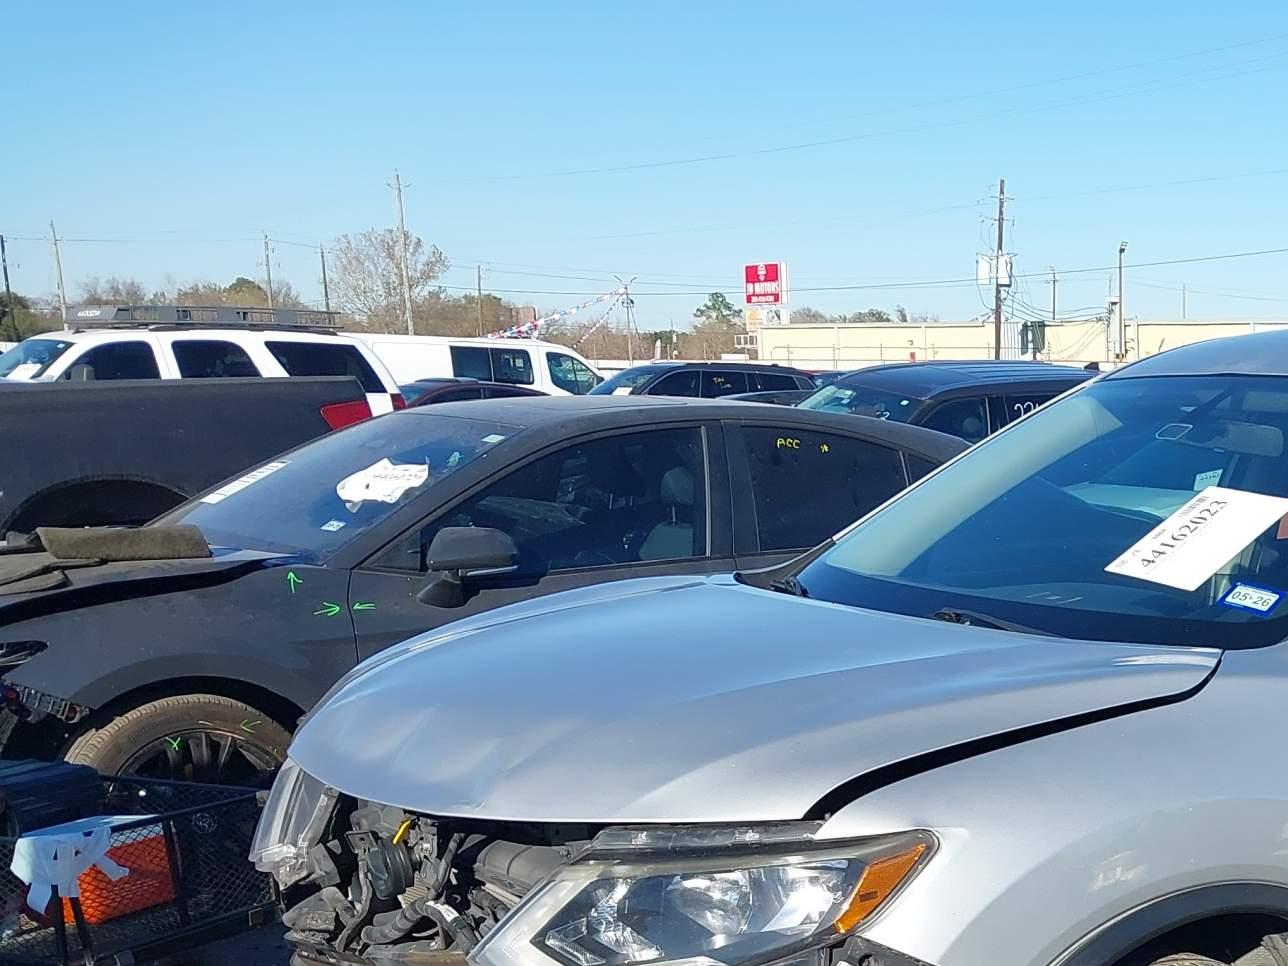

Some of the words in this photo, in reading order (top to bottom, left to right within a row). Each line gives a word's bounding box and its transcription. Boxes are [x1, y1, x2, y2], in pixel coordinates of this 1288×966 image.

[754, 280, 779, 295] MOTORS
[776, 438, 801, 449] ACC
[1141, 500, 1228, 568] 44162023
[1231, 591, 1249, 601] 05
[1252, 596, 1272, 607] 26
